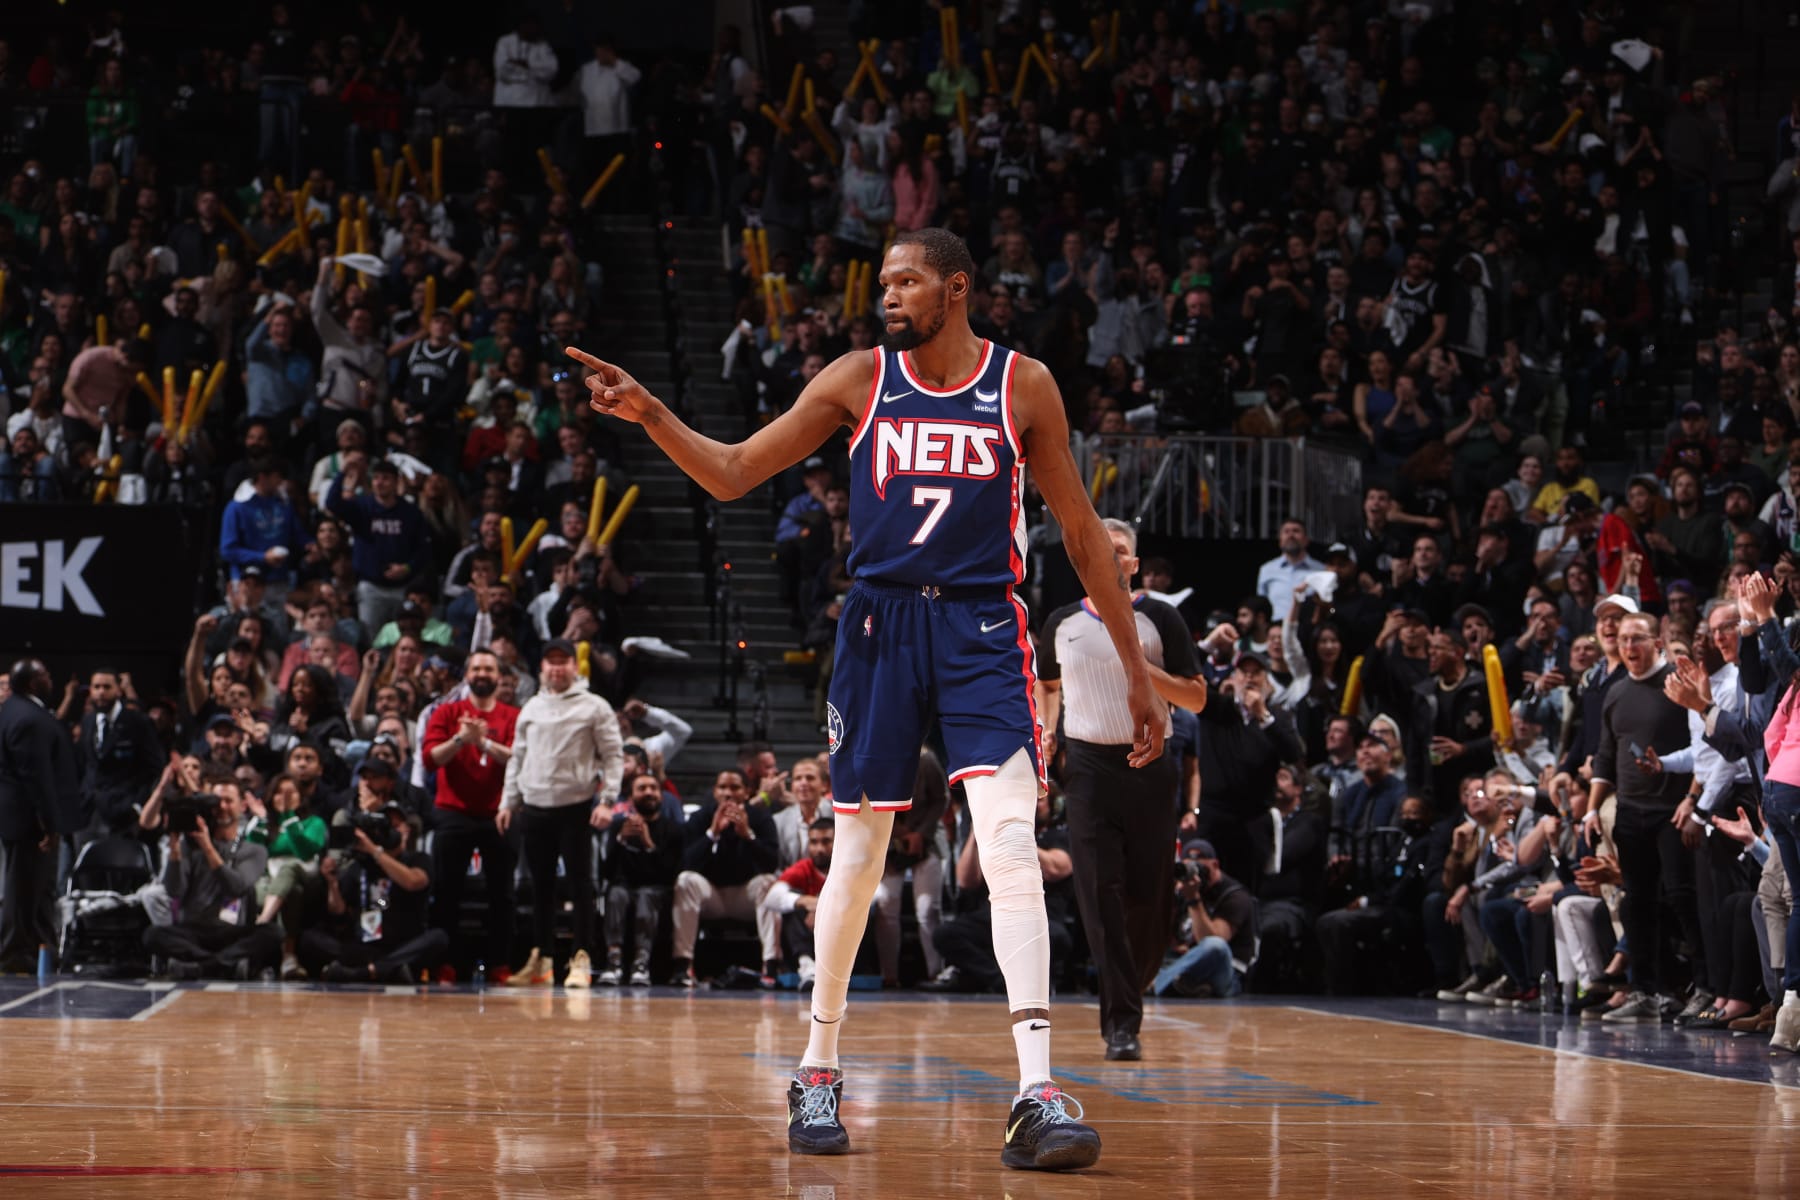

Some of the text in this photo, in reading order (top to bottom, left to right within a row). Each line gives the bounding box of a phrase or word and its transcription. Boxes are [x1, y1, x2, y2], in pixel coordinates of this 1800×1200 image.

[974, 403, 998, 414] Webull
[873, 417, 1003, 500] NETS
[909, 485, 953, 545] 7
[0, 535, 107, 618] EK
